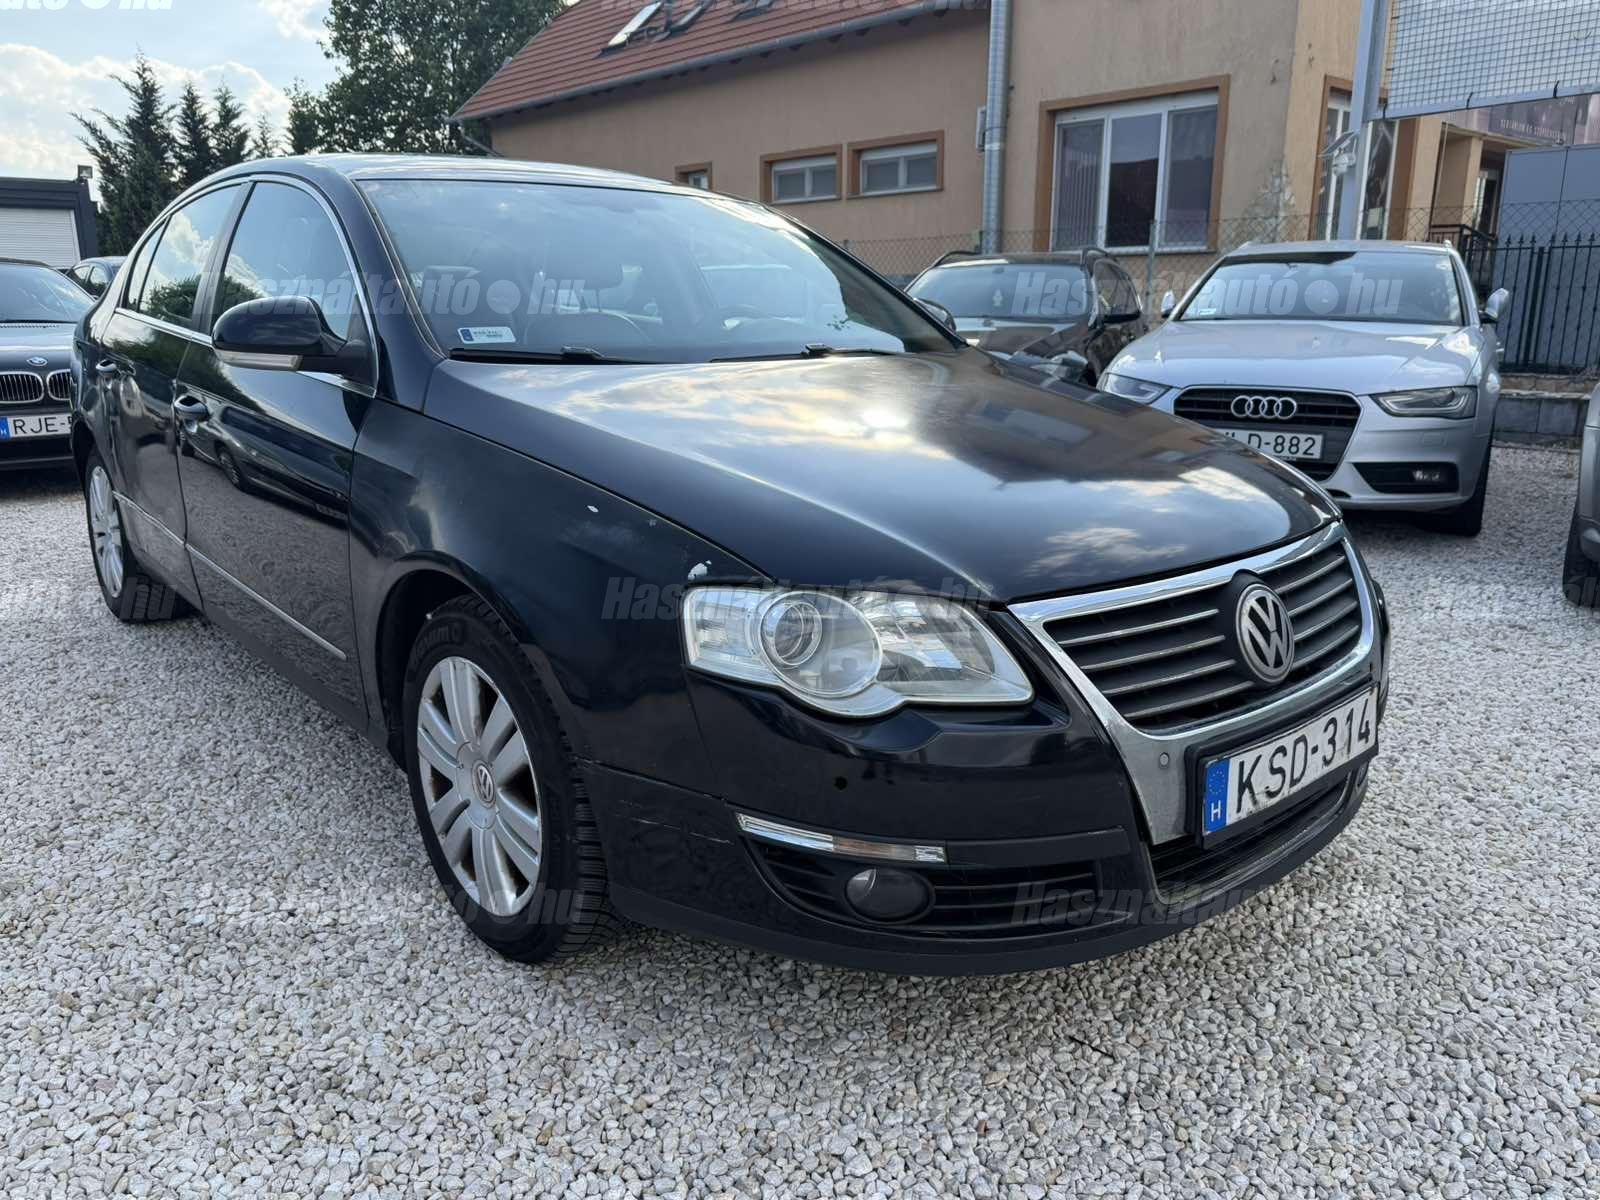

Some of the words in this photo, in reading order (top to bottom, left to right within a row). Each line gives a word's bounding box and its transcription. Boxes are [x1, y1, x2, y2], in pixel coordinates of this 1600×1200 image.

[1225, 431, 1316, 456] D-882
[1235, 698, 1371, 814] KSD-314
[1210, 800, 1222, 823] H
